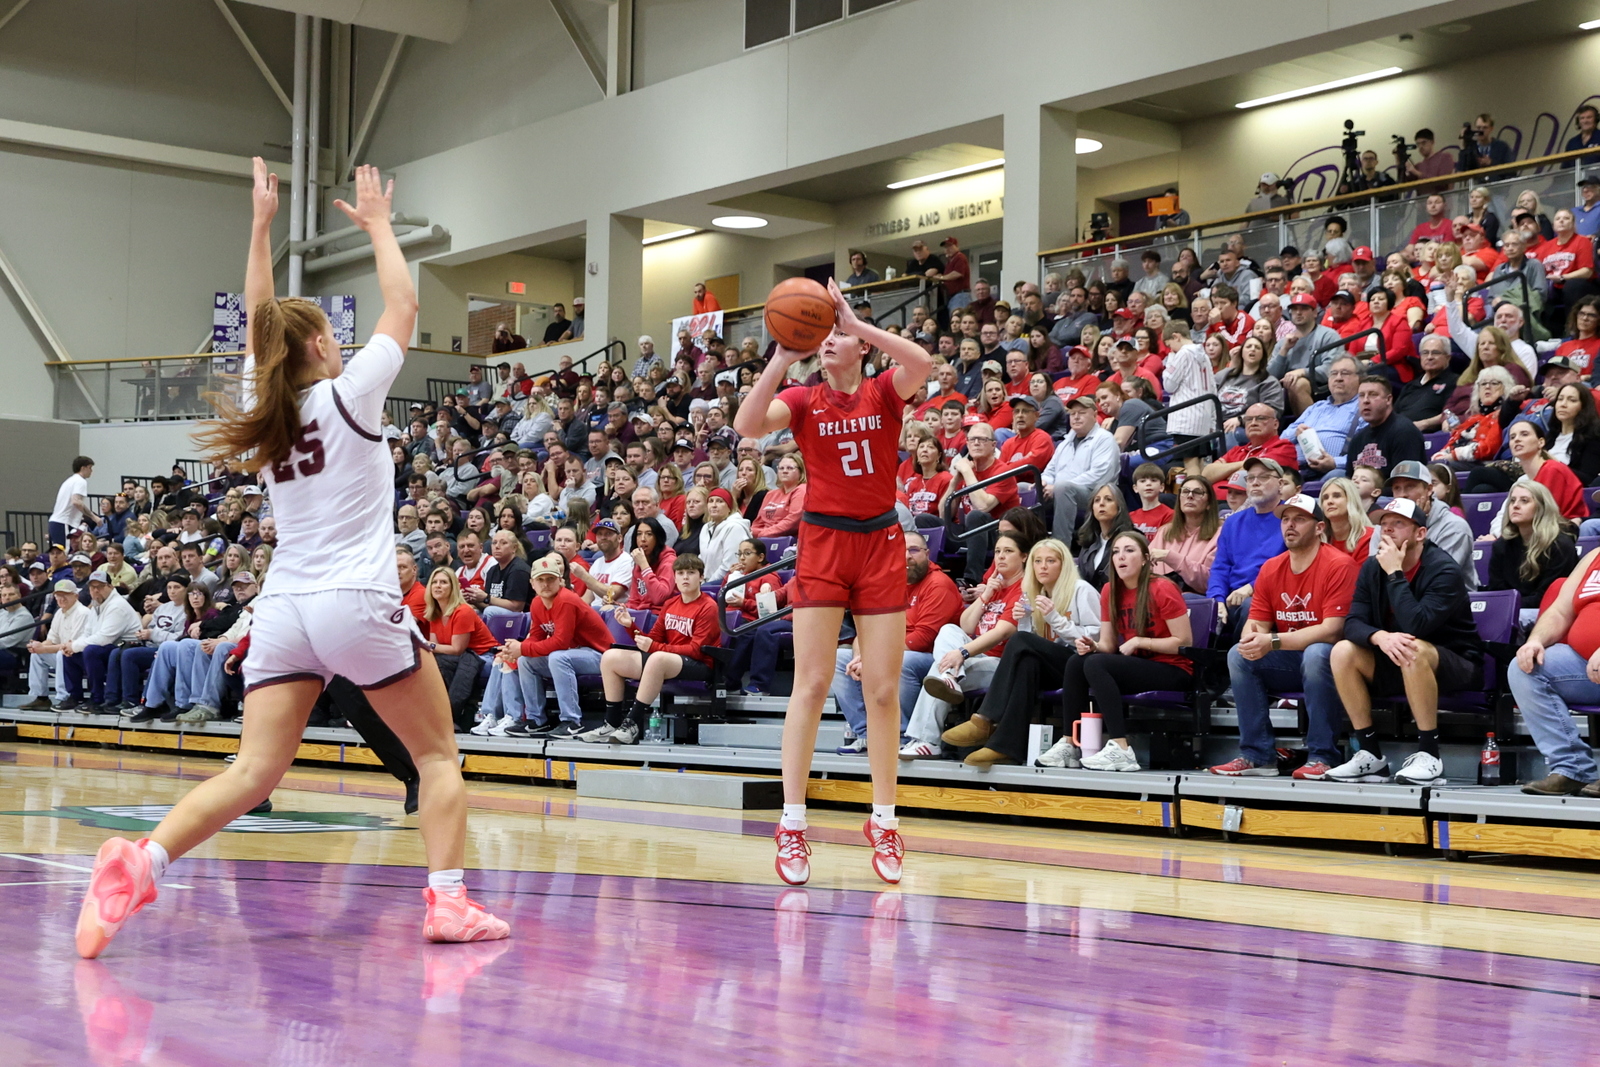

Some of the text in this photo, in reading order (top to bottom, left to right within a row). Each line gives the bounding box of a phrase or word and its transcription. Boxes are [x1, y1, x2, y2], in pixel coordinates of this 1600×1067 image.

[918, 211, 940, 228] AND
[948, 199, 992, 220] WEIGHT
[818, 414, 882, 437] BELLEVUE
[838, 438, 874, 477] 21
[1480, 502, 1489, 510] 38
[1472, 602, 1483, 611] 40
[1276, 610, 1318, 621] BASEBALL
